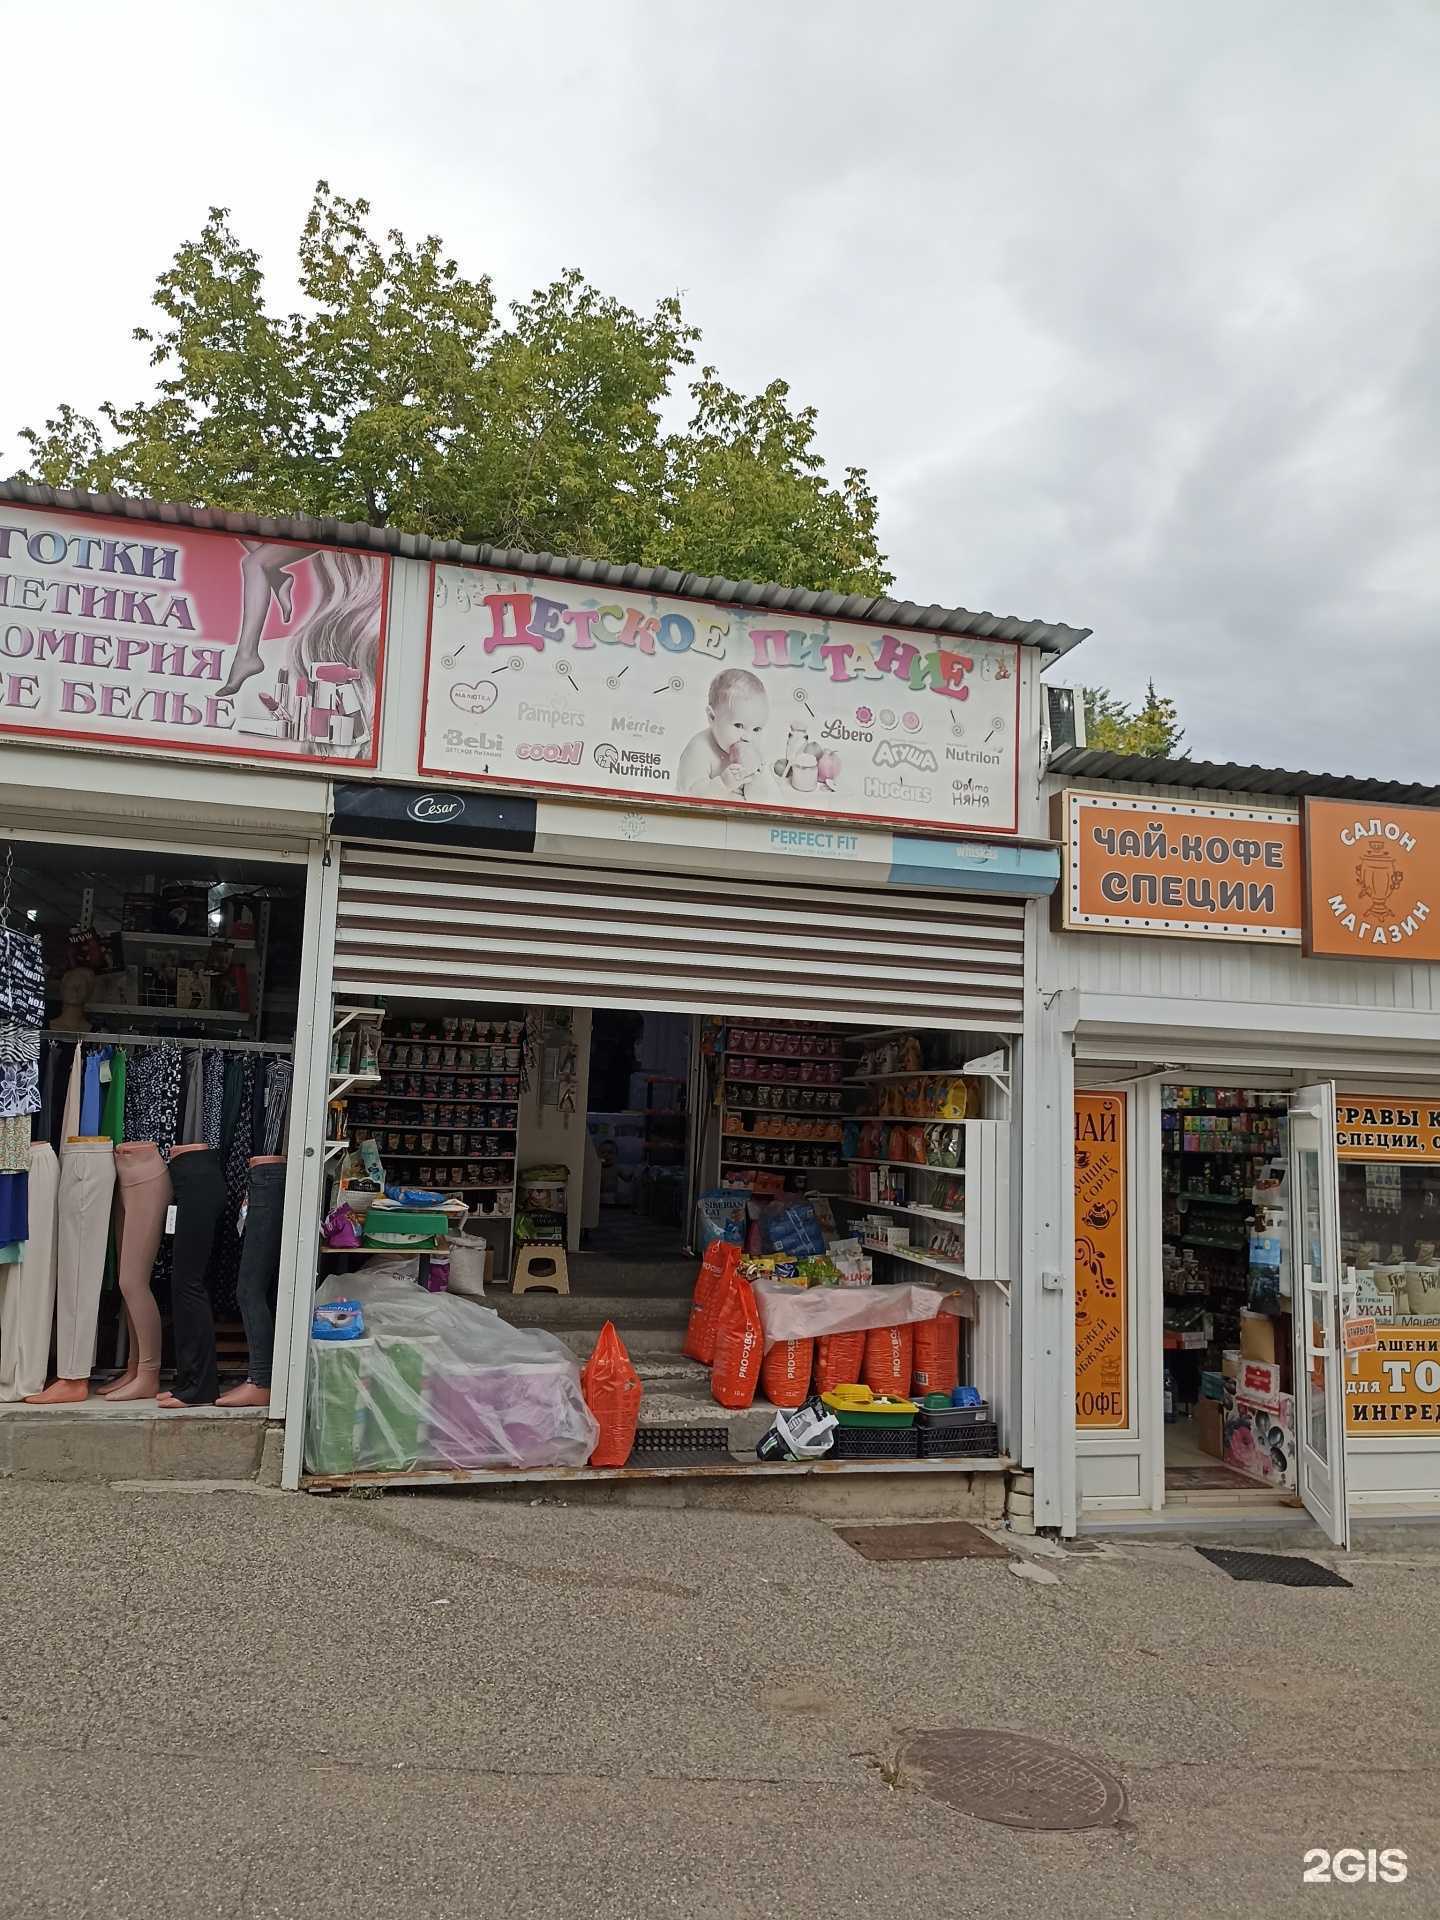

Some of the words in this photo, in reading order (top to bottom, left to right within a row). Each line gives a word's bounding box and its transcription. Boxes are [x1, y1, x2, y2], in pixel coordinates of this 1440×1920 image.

[483, 593, 730, 661] ДЕТСКОЕ
[749, 629, 974, 702] ПИТАНИЕ
[59, 678, 237, 730] БЕЛЬЕ
[517, 701, 585, 728] Pampers
[611, 716, 666, 736] Merries
[820, 719, 873, 744] Libero
[446, 728, 503, 751] Bebi
[945, 746, 1000, 766] Nutrilon
[609, 762, 670, 780] Nutrition
[414, 797, 458, 817] Cesar
[952, 792, 990, 808] НЯНЯ
[770, 829, 833, 848] PERFECT
[837, 835, 858, 850] FIT
[1340, 819, 1417, 852] САЛОН
[1100, 871, 1276, 913] СПЕЦИИ
[1327, 894, 1431, 945] МАГАЗИН
[1336, 1132, 1425, 1150] СПЕЦИИ,
